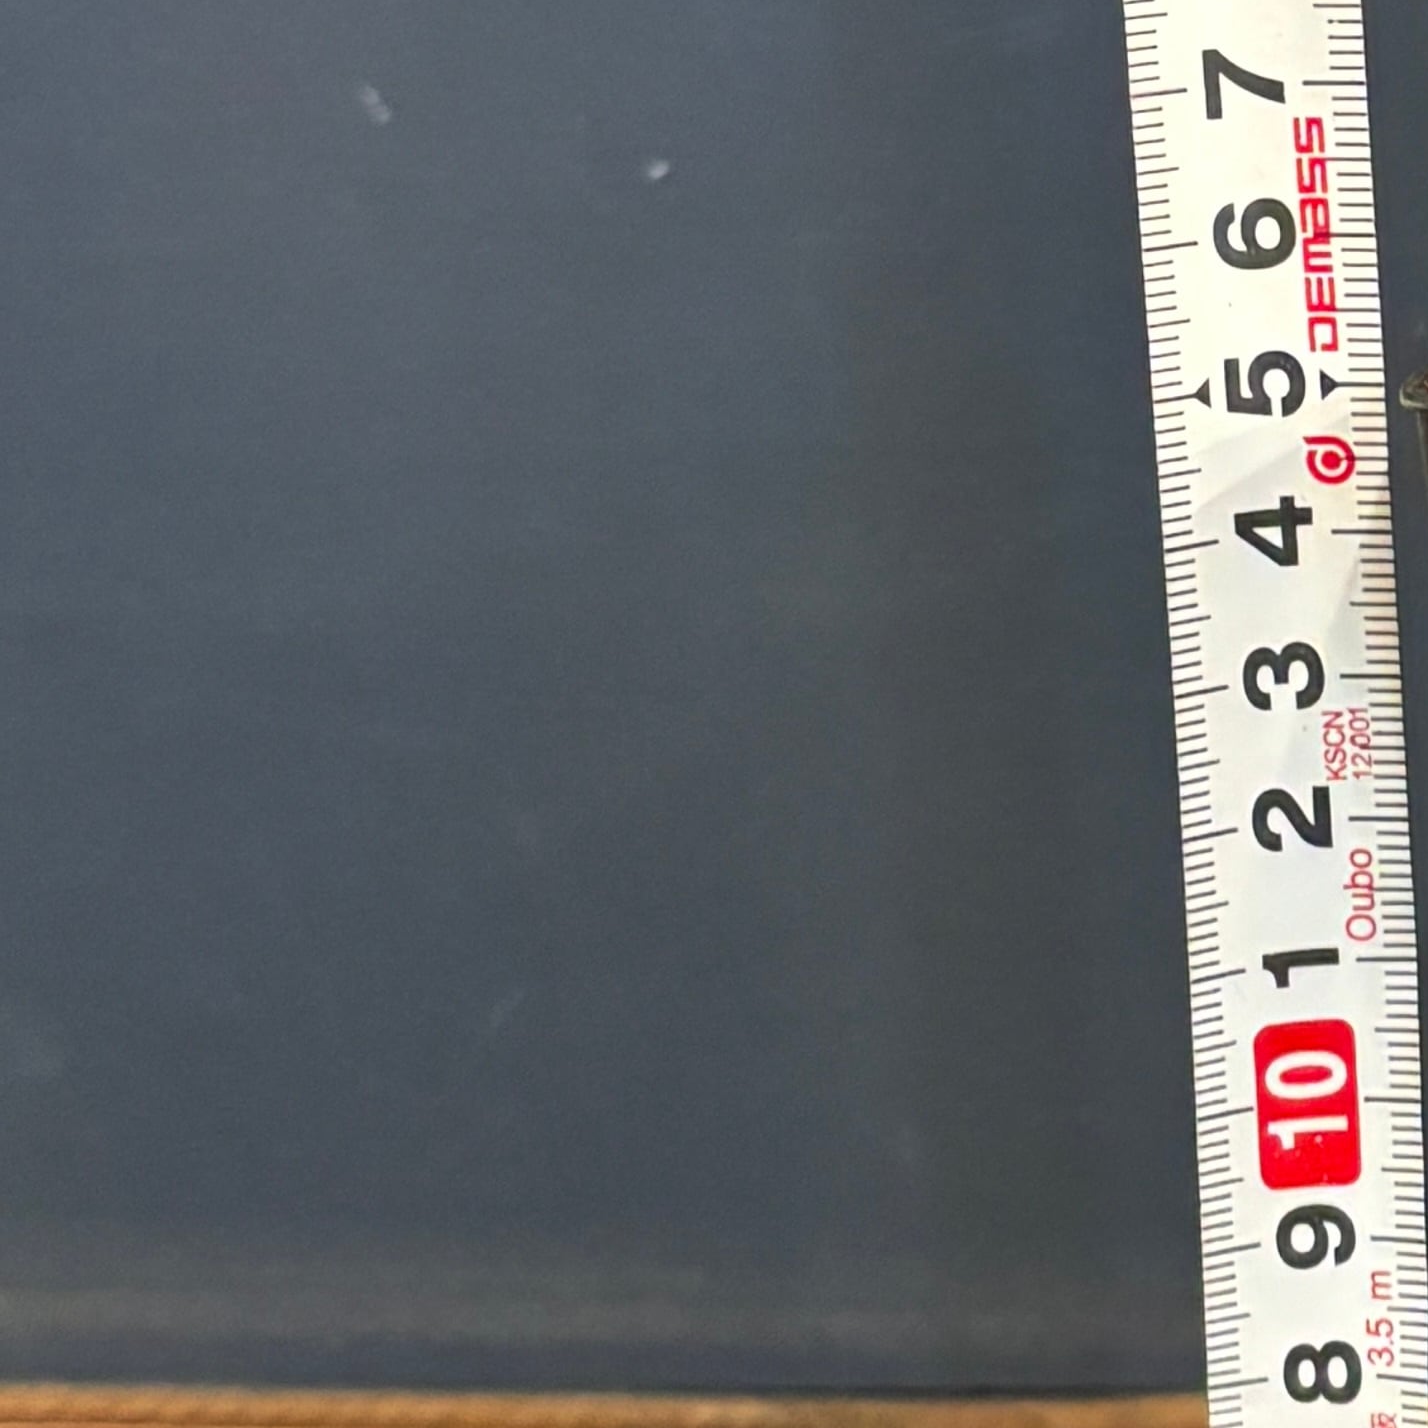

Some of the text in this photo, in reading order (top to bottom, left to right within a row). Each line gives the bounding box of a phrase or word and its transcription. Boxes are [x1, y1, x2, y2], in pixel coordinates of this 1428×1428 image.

[1202, 49, 1285, 120] 7
[1213, 197, 1296, 270] 6
[1224, 350, 1305, 417] 5
[1234, 496, 1312, 566] 4
[1243, 641, 1324, 710] 3
[1321, 710, 1348, 781] KSCN
[1252, 786, 1333, 852] 2
[1343, 848, 1377, 942] Oubo
[1262, 947, 1339, 988] 1
[1265, 1049, 1348, 1151] 10
[1276, 1203, 1356, 1270] 9
[1370, 1271, 1393, 1300] m
[1283, 1340, 1362, 1404] 8
[1366, 1318, 1394, 1367] 3.5
